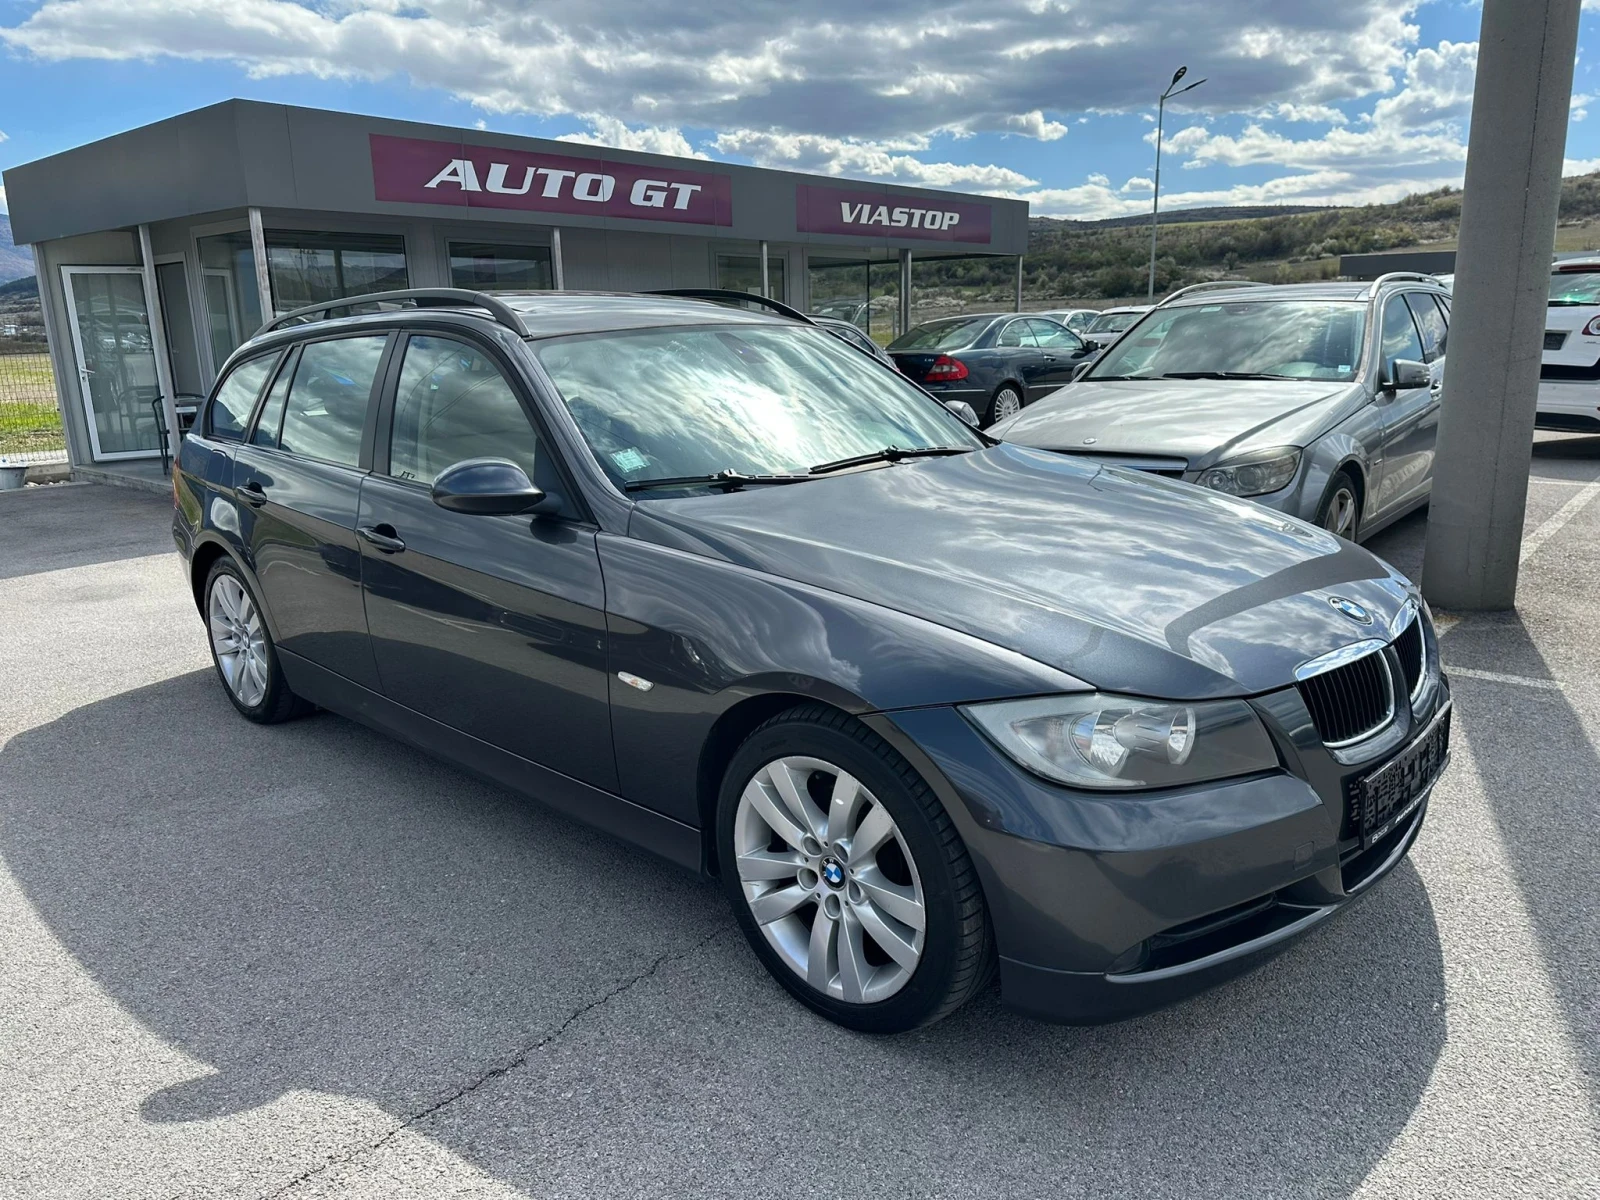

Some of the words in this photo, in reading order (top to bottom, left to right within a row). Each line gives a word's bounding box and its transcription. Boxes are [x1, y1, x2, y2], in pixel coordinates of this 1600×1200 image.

[424, 159, 616, 202] AUTO
[629, 178, 702, 210] GT
[840, 201, 960, 231] VIASTOP
